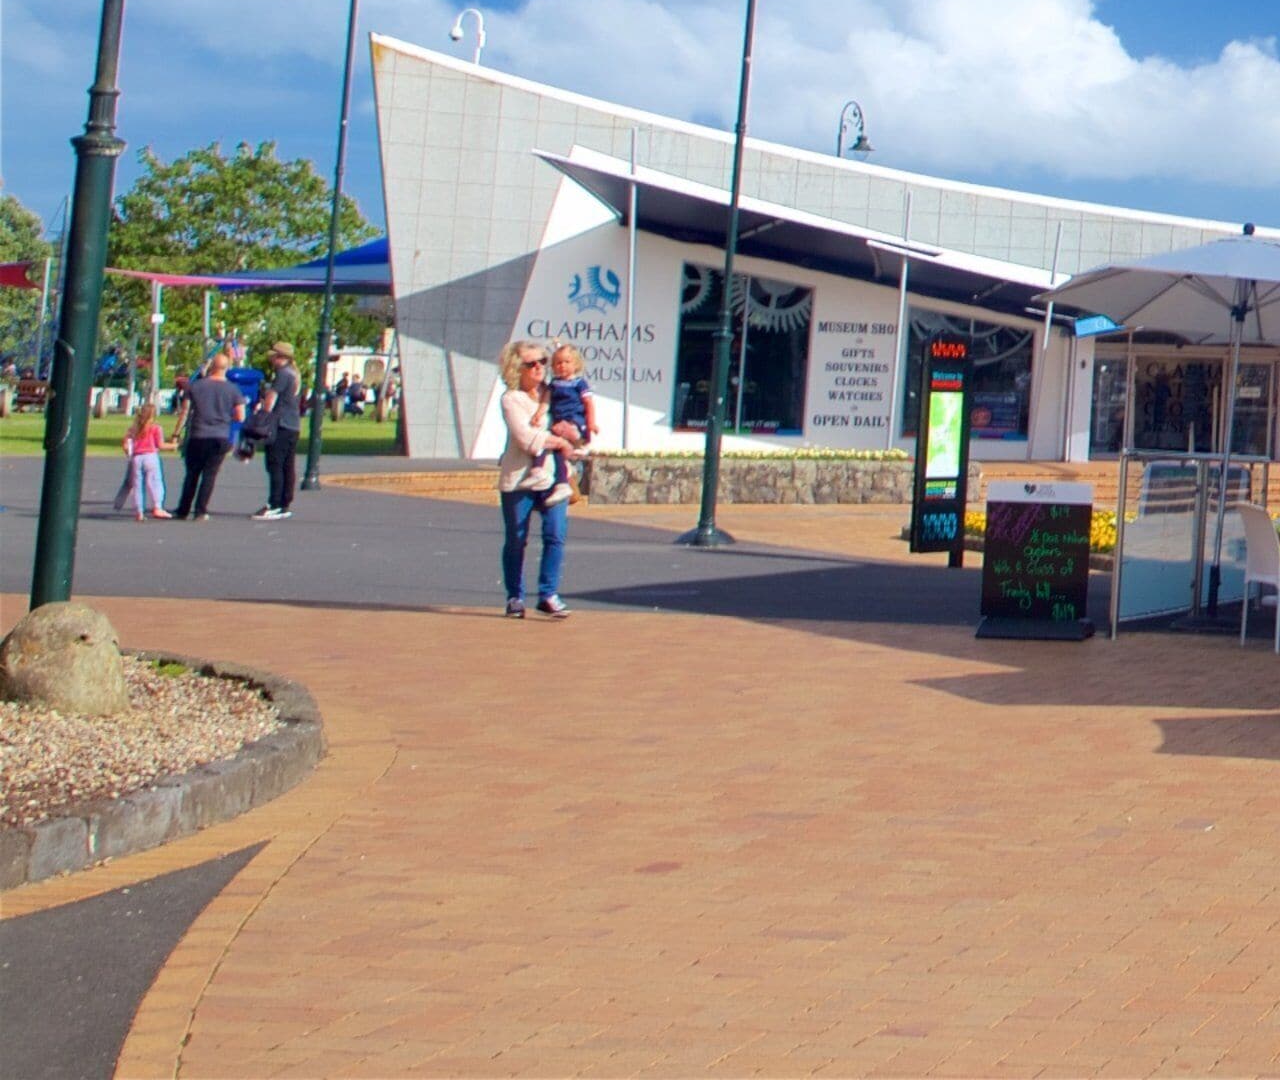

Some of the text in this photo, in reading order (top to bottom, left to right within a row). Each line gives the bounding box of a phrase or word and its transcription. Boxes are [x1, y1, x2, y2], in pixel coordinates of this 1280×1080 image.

[527, 320, 656, 342] CLAPHAMS
[818, 322, 898, 335] MUSEUM SHO
[842, 348, 875, 358] GIFTS
[825, 361, 889, 373] SOUVENIRS
[586, 368, 662, 383] MUSUM
[835, 377, 878, 386] CLOCKS
[828, 391, 883, 400] WATCHES
[813, 414, 848, 426] OPEN
